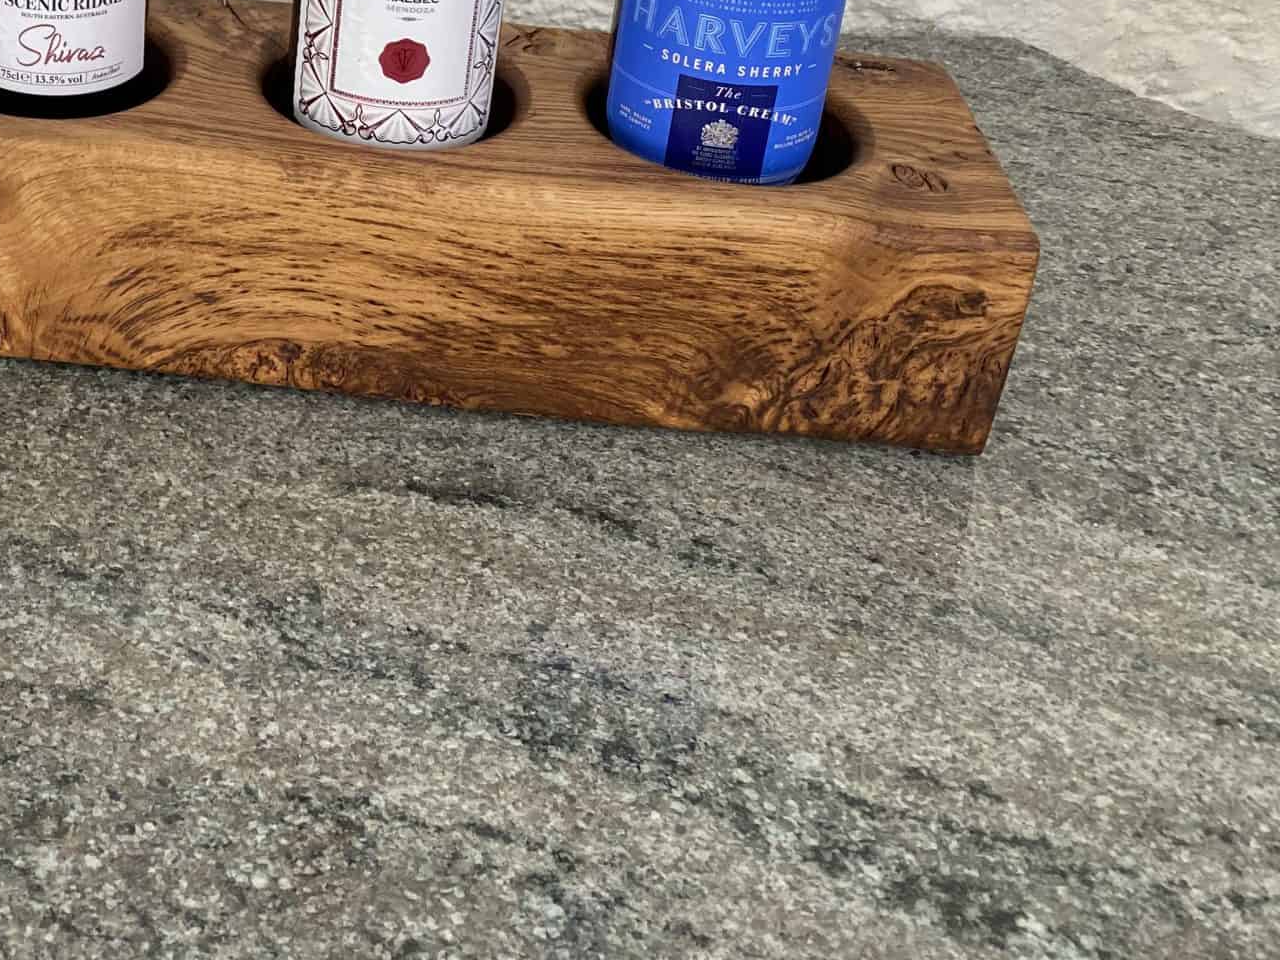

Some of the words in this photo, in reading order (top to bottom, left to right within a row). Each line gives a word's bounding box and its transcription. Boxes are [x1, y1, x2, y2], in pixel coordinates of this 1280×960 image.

[386, 4, 436, 14] MENDOZA
[15, 23, 106, 67] Shiraz
[661, 48, 726, 75] SOLERA
[737, 63, 804, 79] SHERRY
[0, 68, 20, 81] 75cl
[35, 74, 65, 84] 13.5%
[67, 74, 83, 84] vol
[714, 86, 743, 100] The
